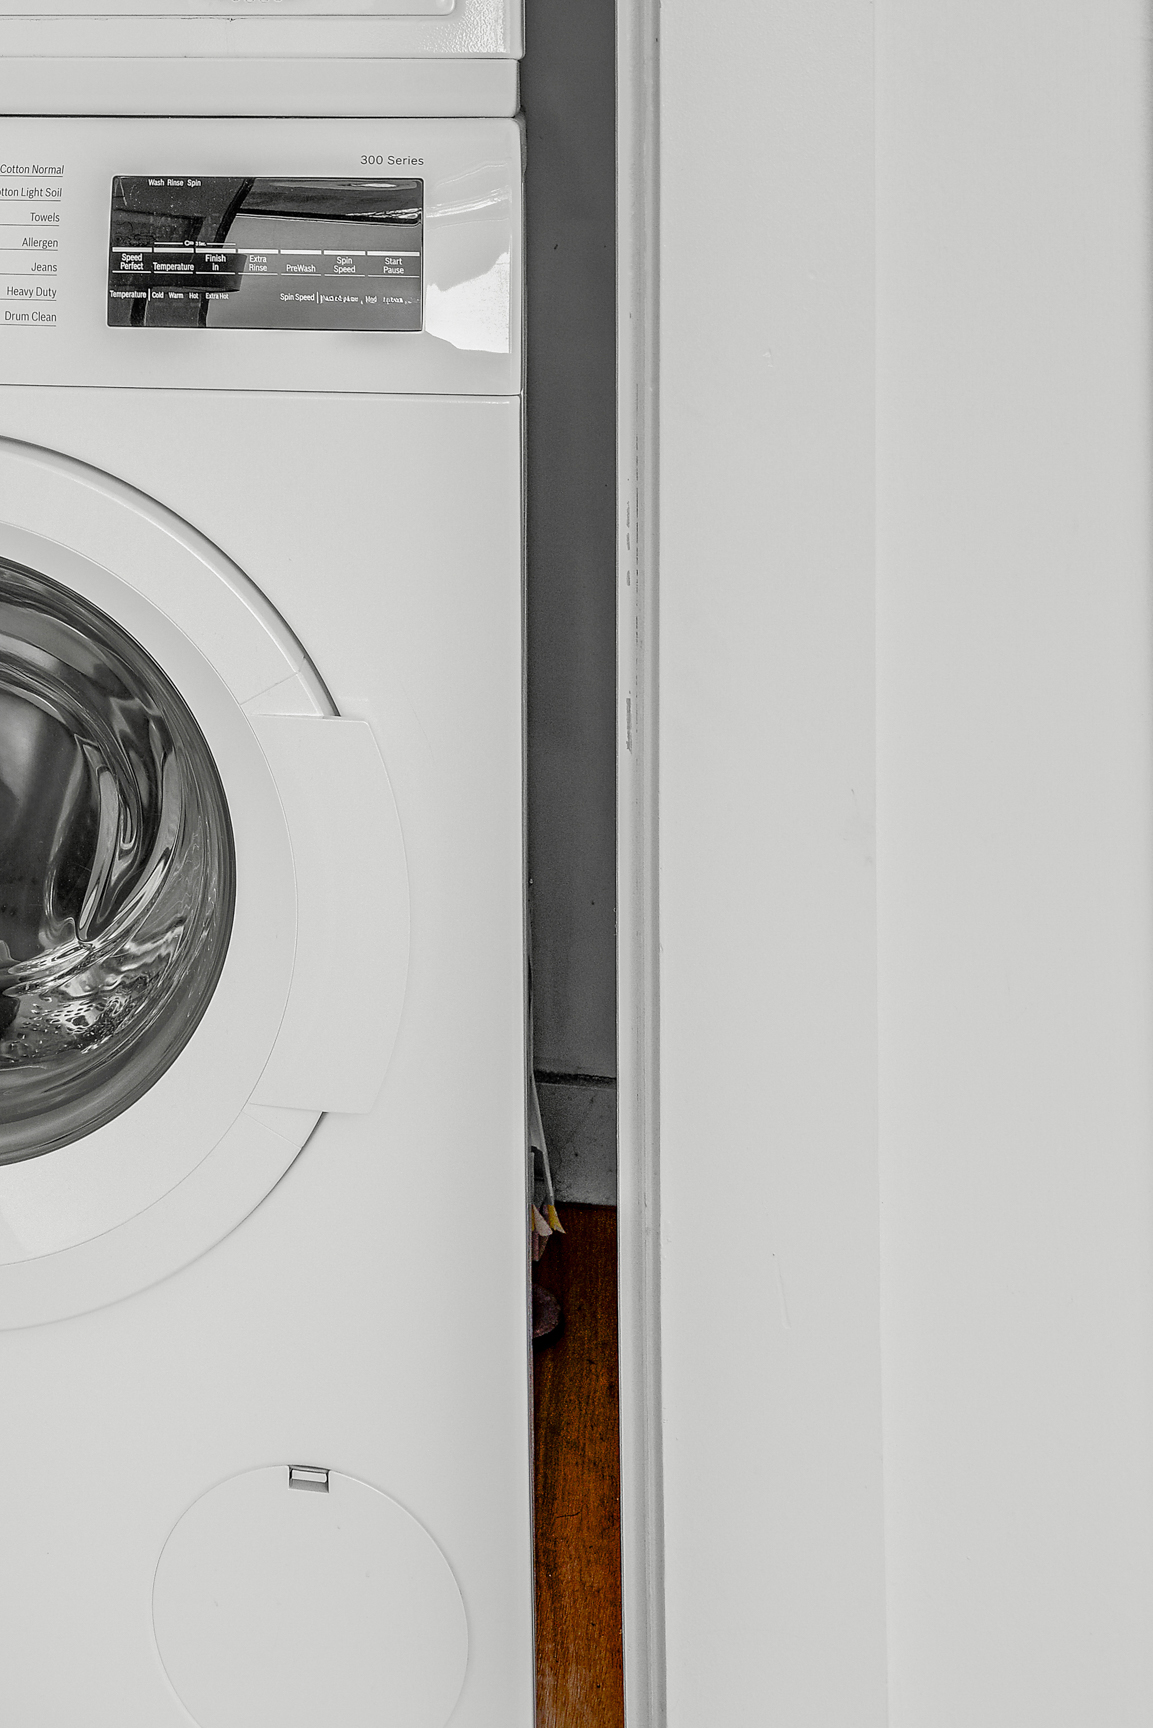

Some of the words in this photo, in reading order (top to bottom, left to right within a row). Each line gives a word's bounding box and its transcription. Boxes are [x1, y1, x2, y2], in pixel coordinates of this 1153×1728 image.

[360, 155, 384, 166] 300
[387, 156, 424, 166] Series
[0, 164, 30, 174] Cotton
[32, 164, 64, 174] Normal
[20, 188, 44, 198] Light
[45, 188, 62, 197] Soil
[30, 212, 60, 222] Towels
[22, 238, 58, 248] Allergen
[122, 254, 142, 262] Speed
[205, 254, 226, 262] Finish
[250, 255, 266, 263] Extra
[336, 257, 352, 265] Spin
[385, 258, 402, 266] Start
[31, 262, 58, 272] Jeans
[120, 262, 144, 270] Perfect
[152, 262, 194, 272] Temperature
[249, 264, 268, 272] Rinse
[286, 264, 316, 272] PreWash
[334, 265, 356, 274] Speed
[384, 266, 404, 274] Pause
[6, 286, 34, 298] Heavy
[36, 287, 56, 298] Duty
[110, 290, 147, 299] Temperature
[280, 293, 294, 302] Spin
[294, 294, 314, 302] Speed
[4, 311, 30, 321] Drum
[32, 312, 56, 322] Clean
